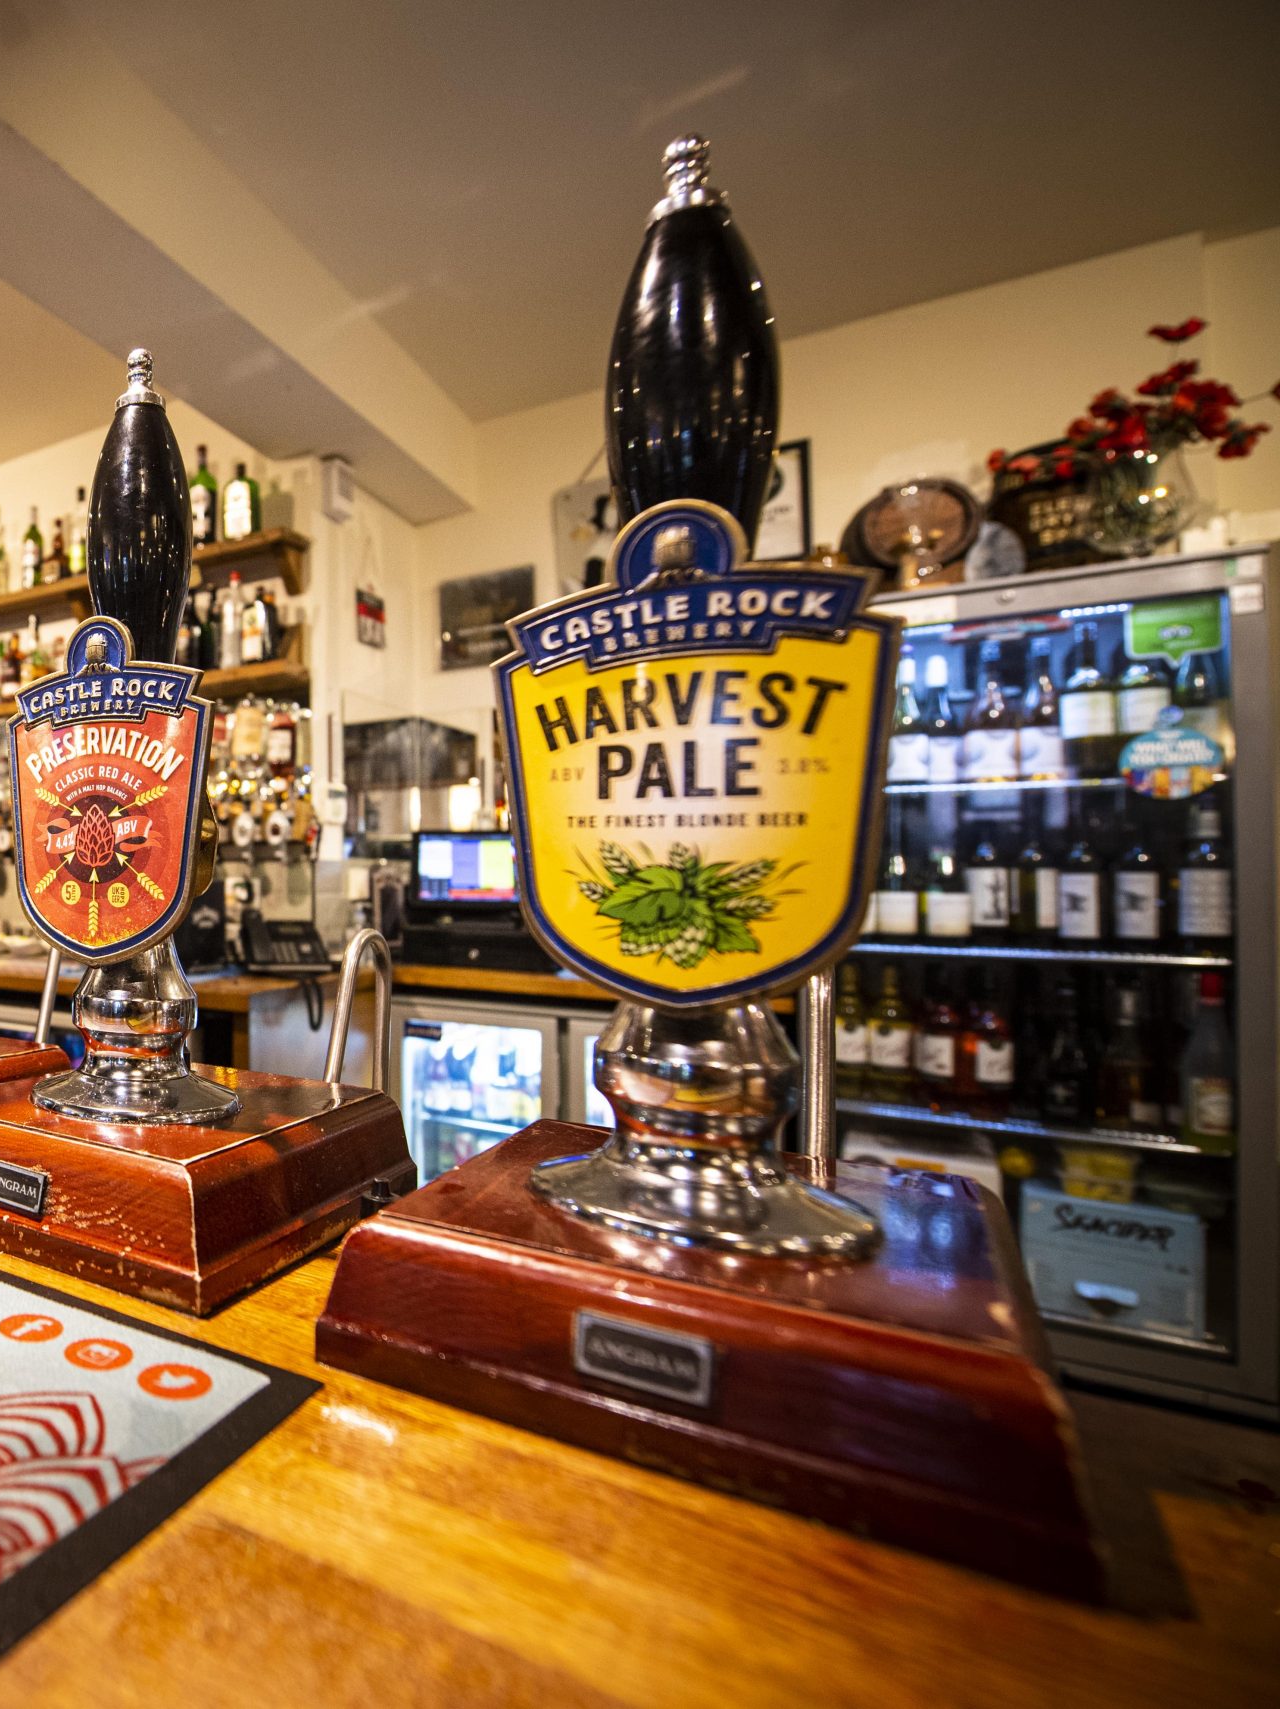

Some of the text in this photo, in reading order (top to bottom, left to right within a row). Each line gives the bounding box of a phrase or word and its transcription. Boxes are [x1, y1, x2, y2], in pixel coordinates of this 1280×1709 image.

[539, 593, 690, 651] CASTLE
[706, 588, 837, 620] ROCK
[602, 619, 759, 653] BREWERY
[29, 677, 176, 714] CASTLE ROCK
[60, 699, 135, 717] BREWERY
[534, 671, 849, 752] HARVEST
[25, 726, 186, 783] PRESERVATION
[54, 765, 143, 793] CLASSIC RED ALE
[549, 767, 586, 782] ABV
[597, 738, 762, 801] PALE
[66, 790, 78, 802] WITH
[82, 784, 95, 793] MALT
[106, 785, 128, 801] BALANCE
[55, 819, 138, 850] 4.4% ABV
[567, 812, 808, 829] THE FINEST BLONDE BEER
[65, 884, 72, 901] 5
[111, 886, 120, 895] UK
